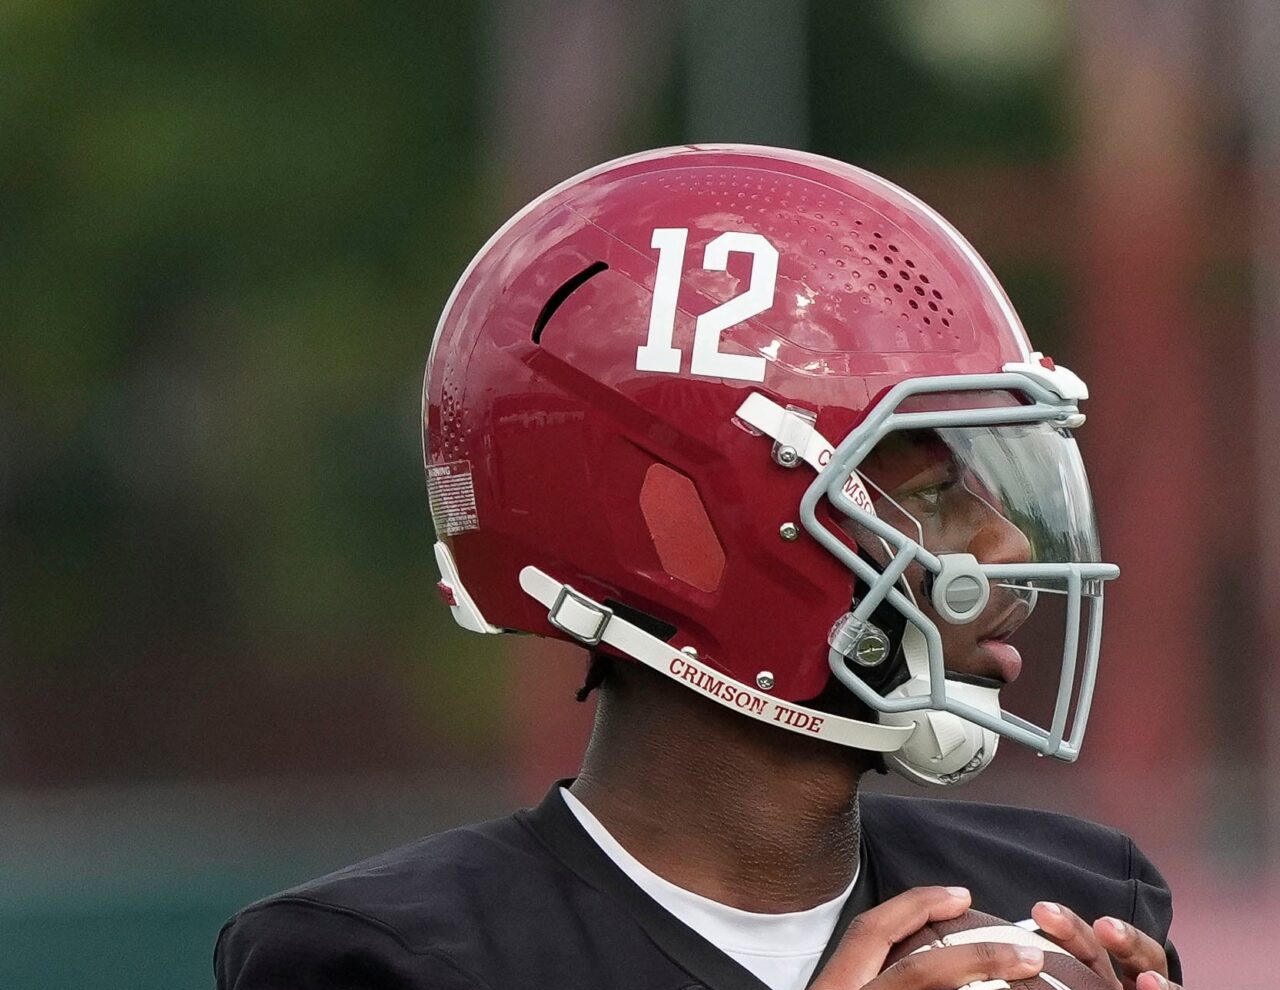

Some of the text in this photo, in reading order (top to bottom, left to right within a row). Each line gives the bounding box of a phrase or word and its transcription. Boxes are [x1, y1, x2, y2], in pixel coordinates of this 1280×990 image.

[635, 227, 780, 383] 12
[669, 657, 825, 733] CRIMSON TIDE
